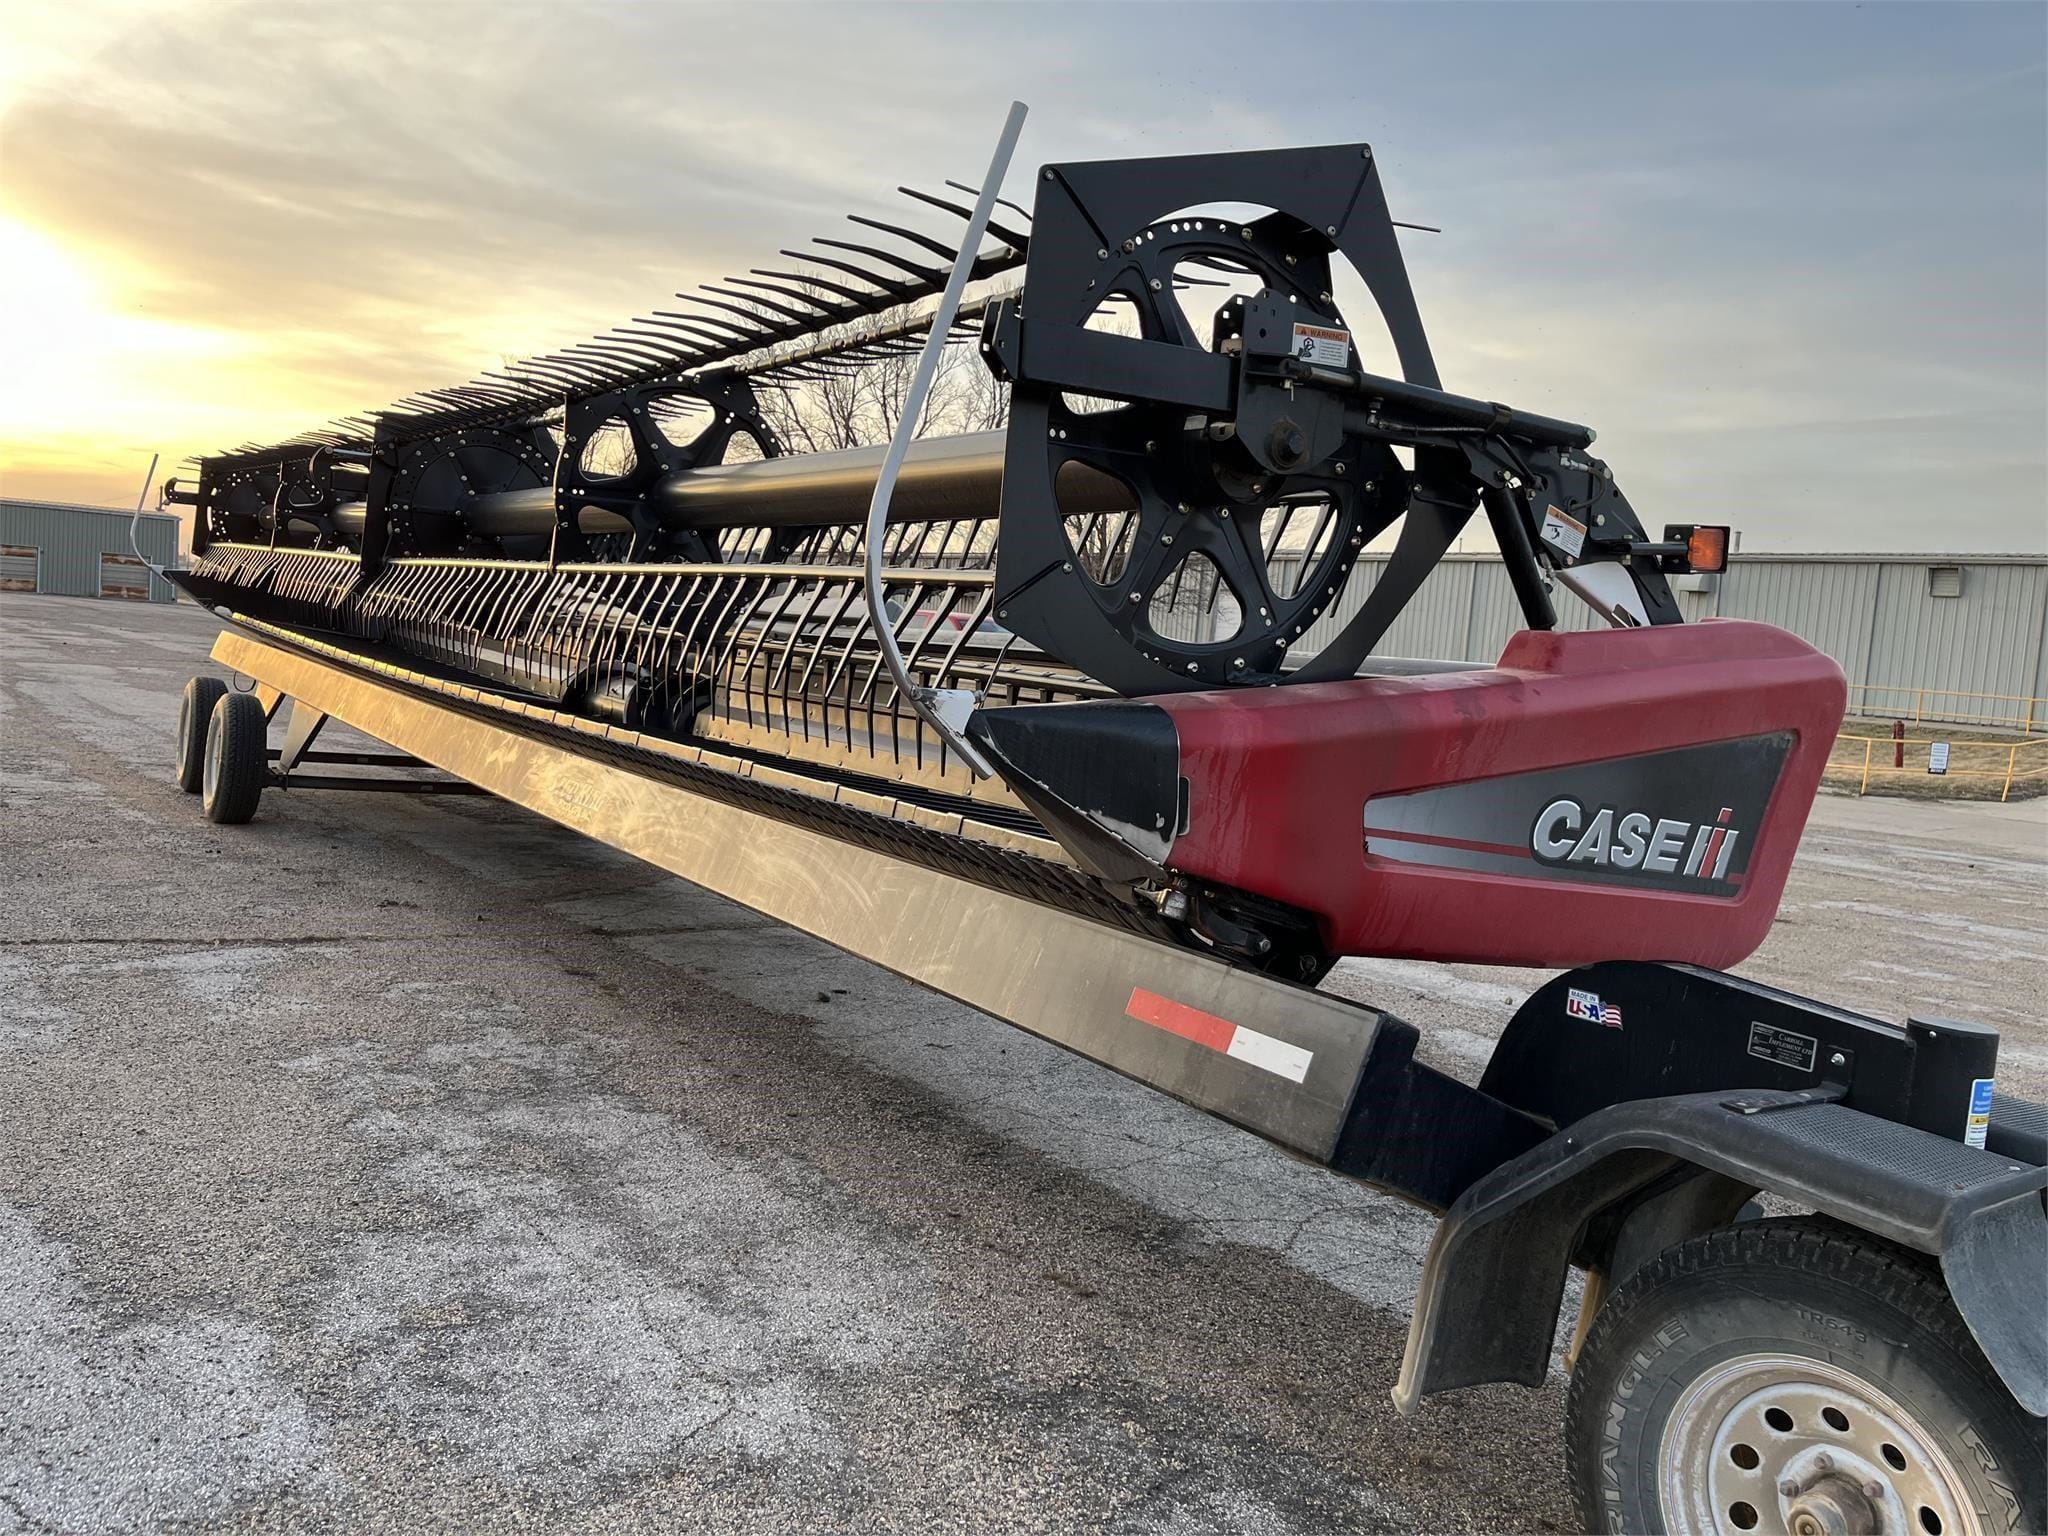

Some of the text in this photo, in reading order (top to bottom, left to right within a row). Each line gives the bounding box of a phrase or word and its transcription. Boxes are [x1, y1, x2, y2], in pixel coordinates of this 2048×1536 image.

[1310, 328, 1343, 341] WARNING
[1533, 799, 1691, 868] CASE
[1571, 990, 1588, 1001] MADE
[1569, 998, 1601, 1021] USA
